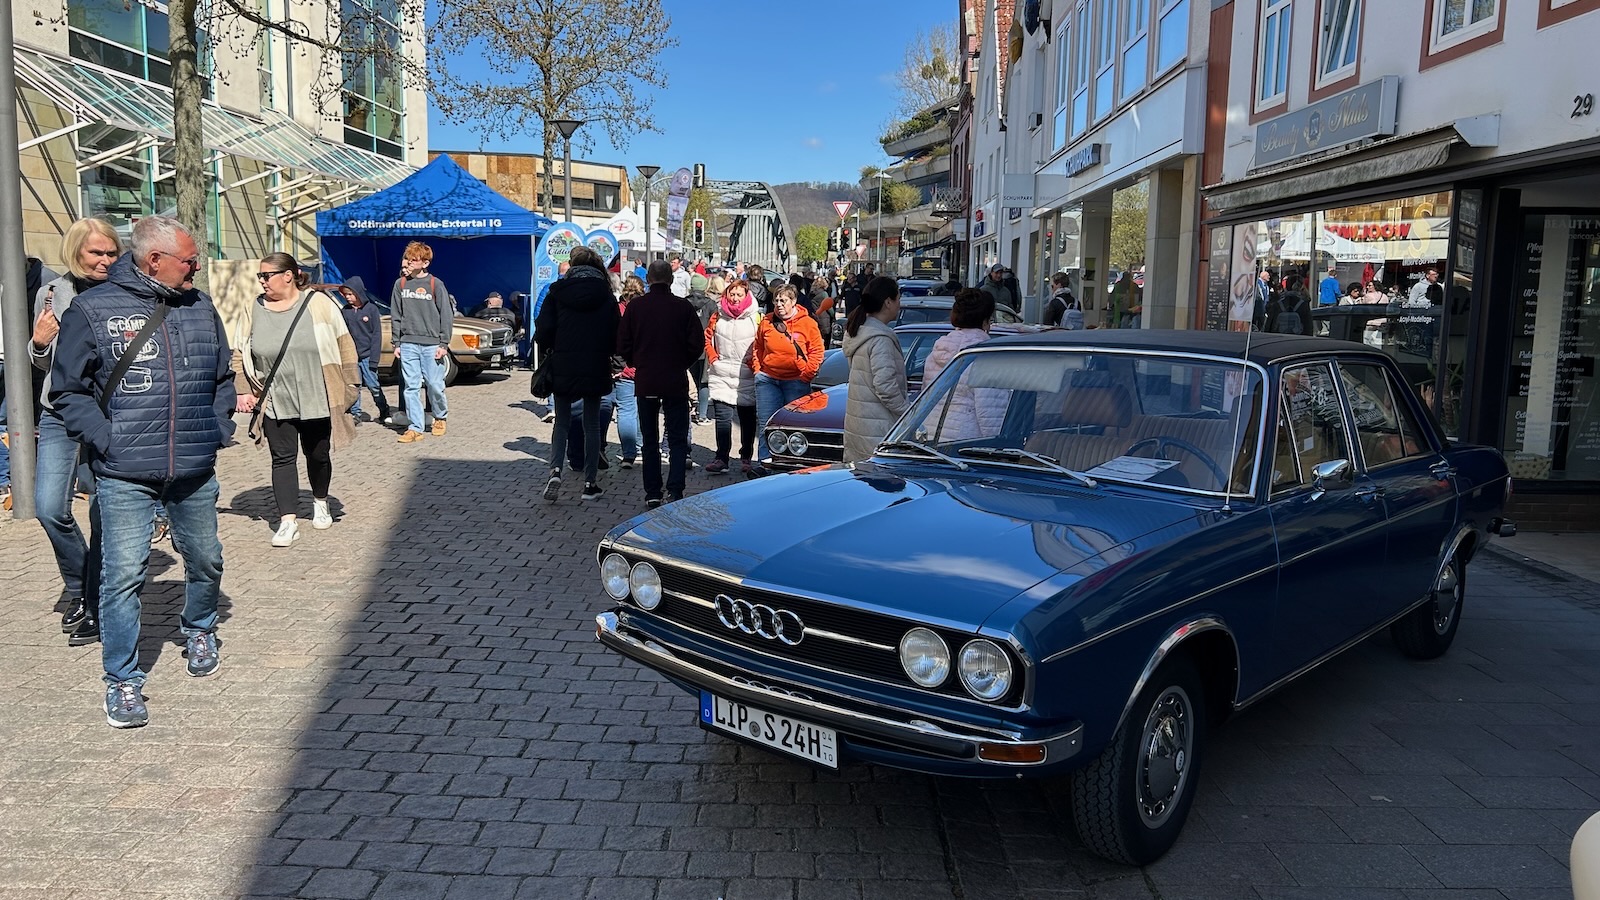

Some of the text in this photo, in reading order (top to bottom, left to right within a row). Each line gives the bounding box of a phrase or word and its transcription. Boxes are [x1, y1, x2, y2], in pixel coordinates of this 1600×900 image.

[1570, 93, 1592, 118] 29
[1261, 92, 1369, 155] Beauty Nails
[348, 219, 502, 229] Oldtimerfreunde-Extertal IG
[119, 319, 147, 331] CAMP
[704, 709, 710, 718] D
[715, 696, 821, 758] LIP S 24H
[822, 731, 832, 741] 04
[823, 752, 833, 762] 10
